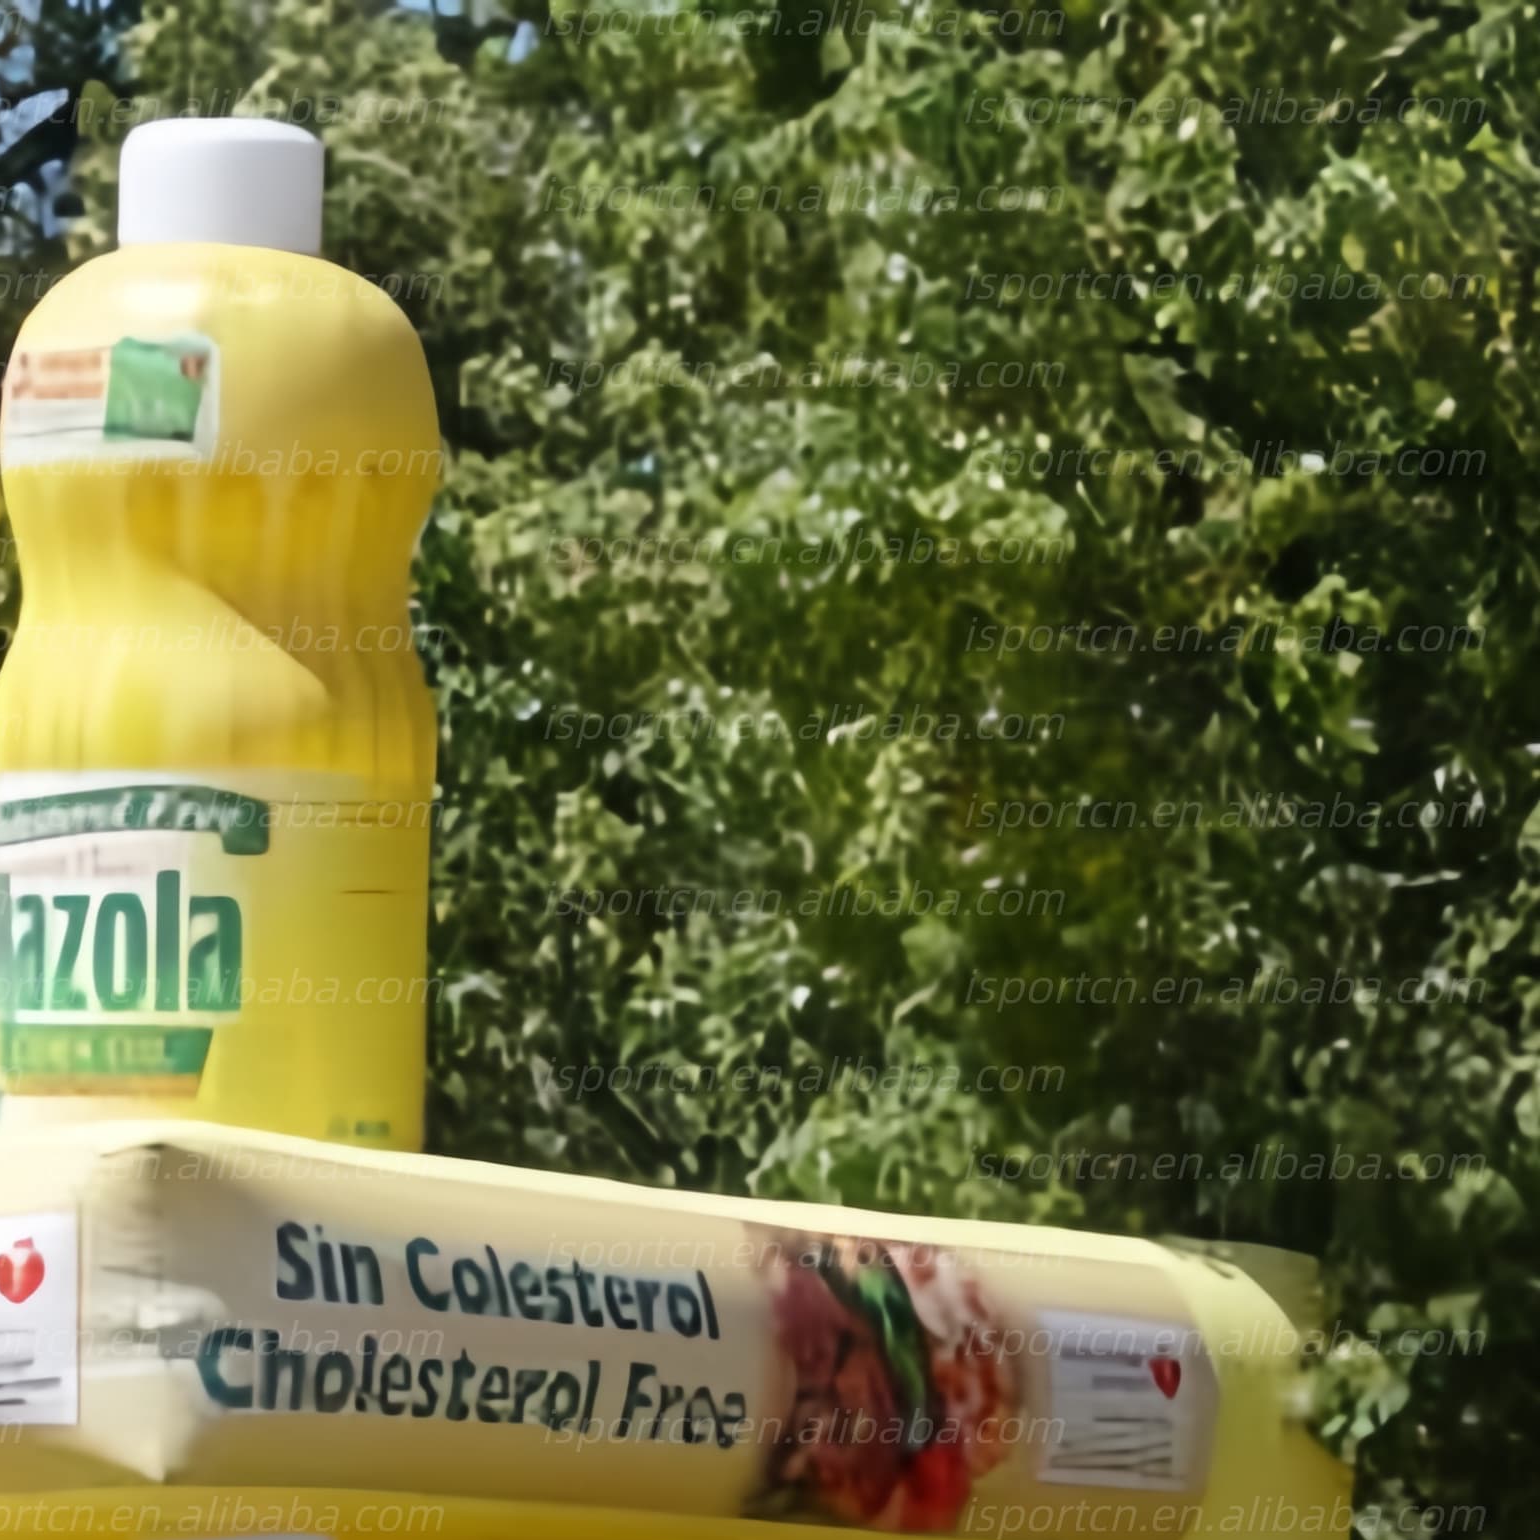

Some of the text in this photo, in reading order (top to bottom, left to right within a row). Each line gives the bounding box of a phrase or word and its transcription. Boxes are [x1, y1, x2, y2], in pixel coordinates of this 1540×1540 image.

[275, 1221, 720, 1341] Sin Colesterol
[197, 1326, 748, 1450] Cholesterol Free
